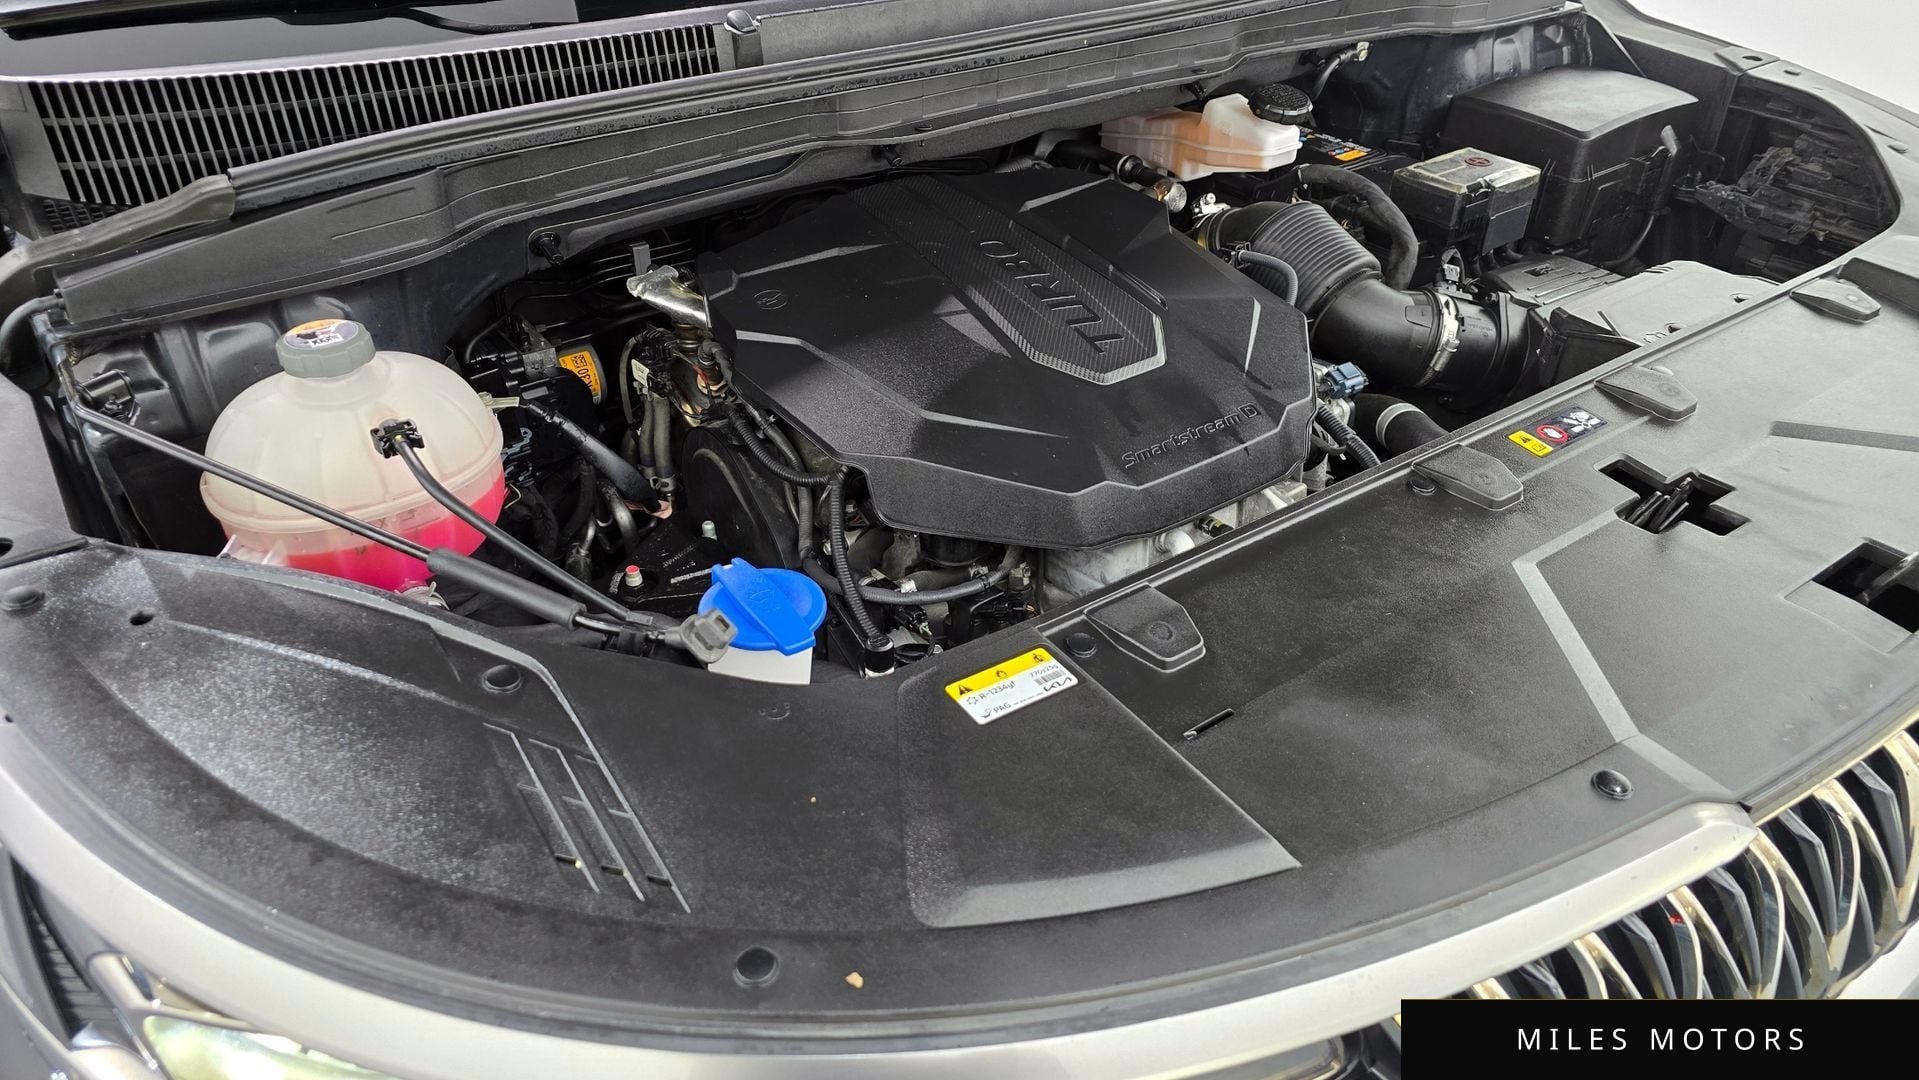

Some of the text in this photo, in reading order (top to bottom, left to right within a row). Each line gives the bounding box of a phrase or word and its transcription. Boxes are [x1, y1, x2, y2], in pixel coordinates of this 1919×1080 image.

[979, 240, 1125, 355] TURBO
[1121, 402, 1261, 469] Smartstream D
[978, 680, 1016, 700] R-1234yf
[992, 702, 1012, 714] PAG
